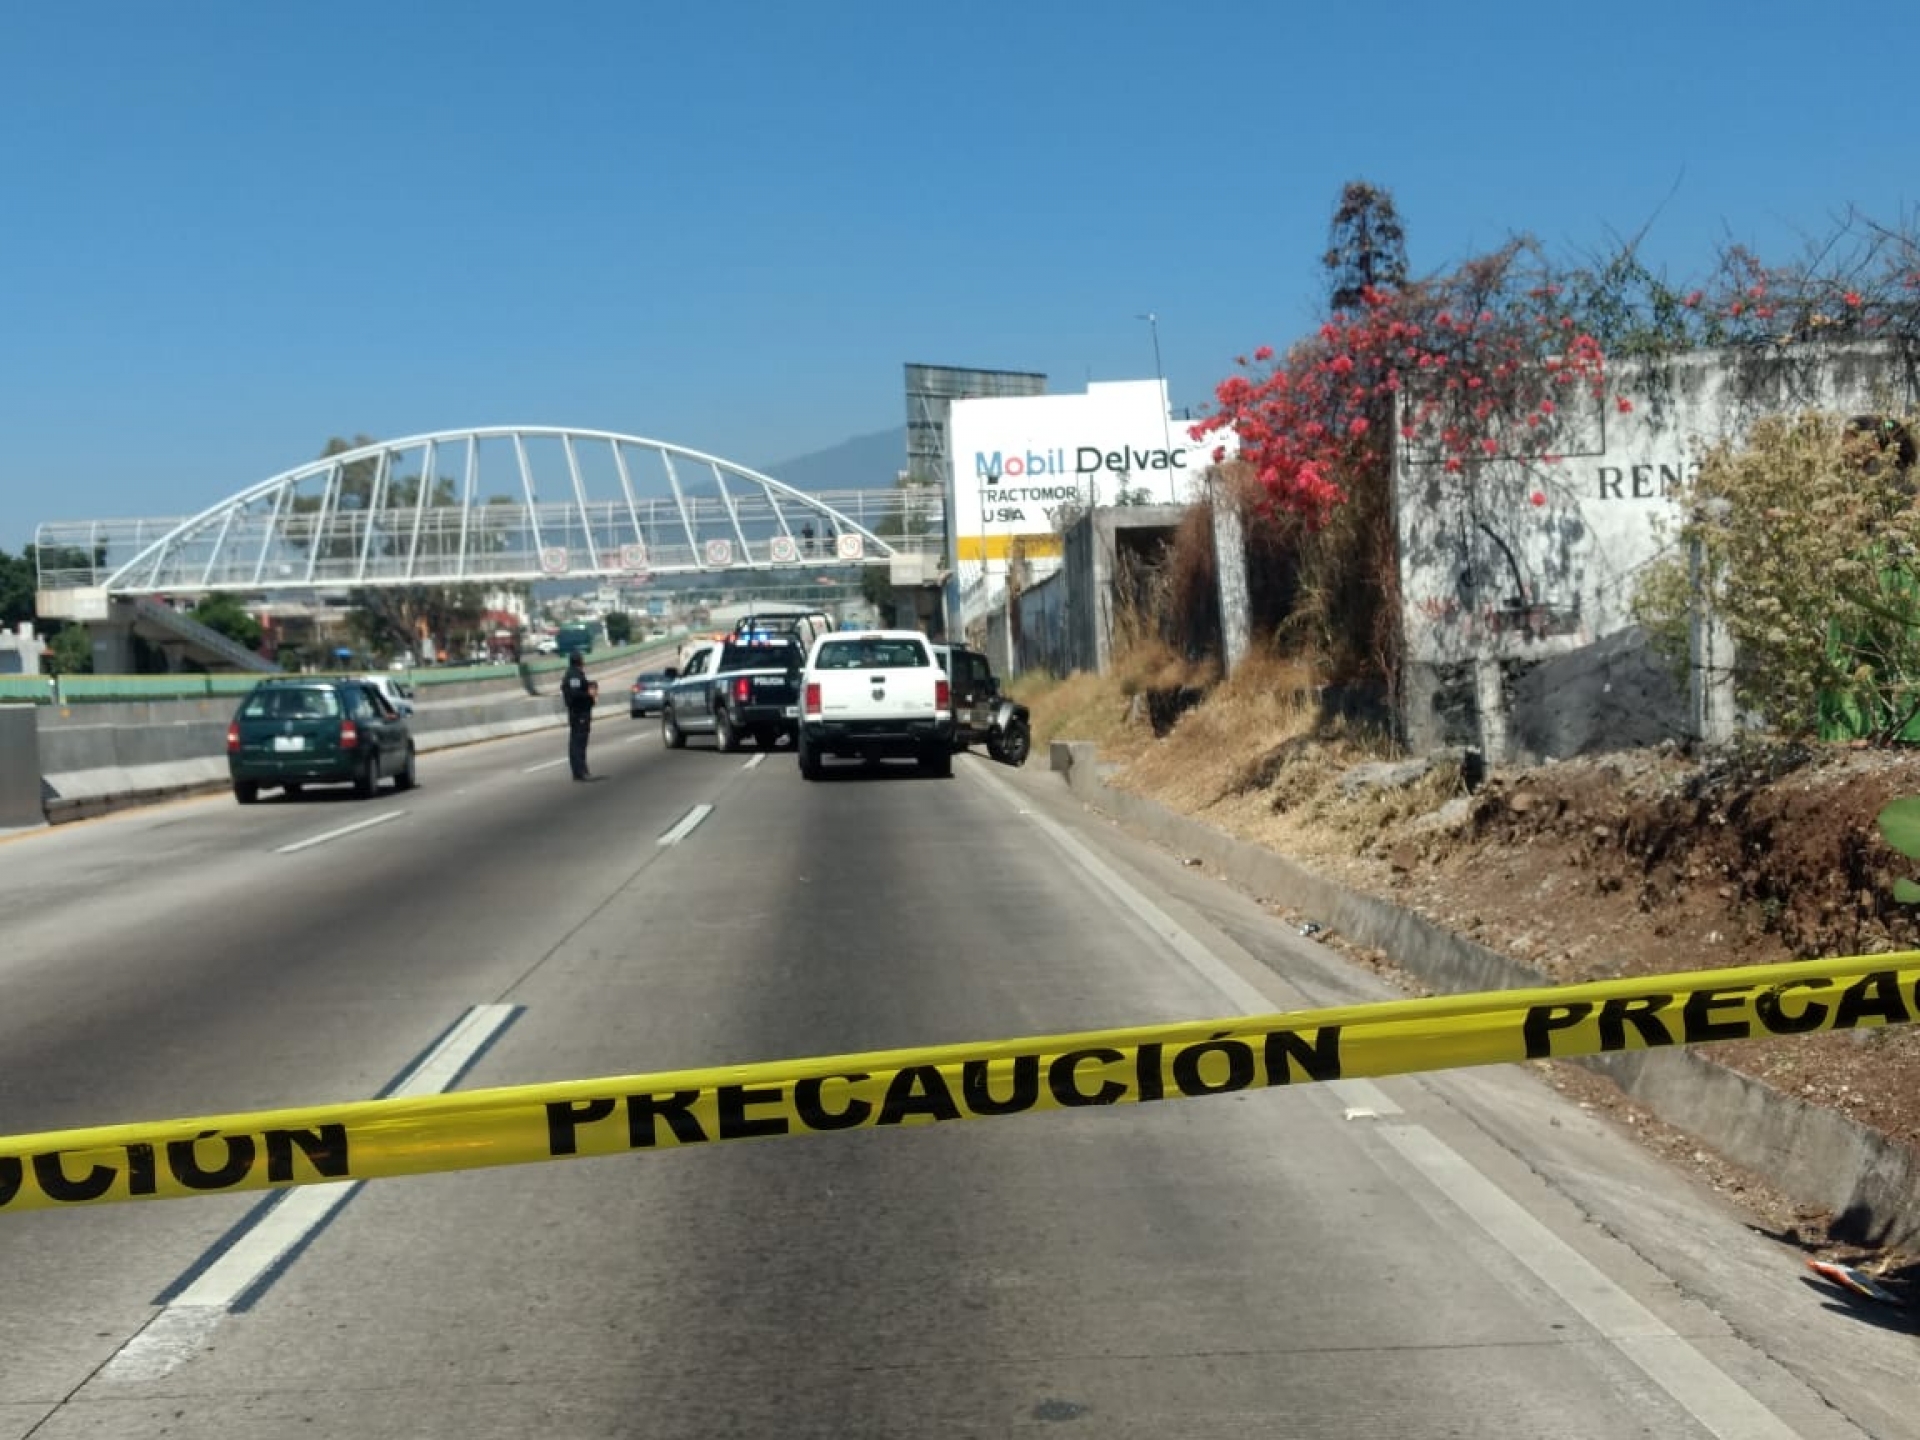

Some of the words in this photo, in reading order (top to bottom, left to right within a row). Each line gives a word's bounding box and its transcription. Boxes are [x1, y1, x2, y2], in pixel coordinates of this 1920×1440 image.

[975, 447, 1064, 478] Mobil
[1076, 444, 1187, 474] Delvac
[982, 507, 1026, 522] USA
[1523, 969, 1920, 1058] PRECA
[546, 1025, 1341, 1156] PRECAUCIÓN
[0, 1122, 350, 1207] CIÓN
